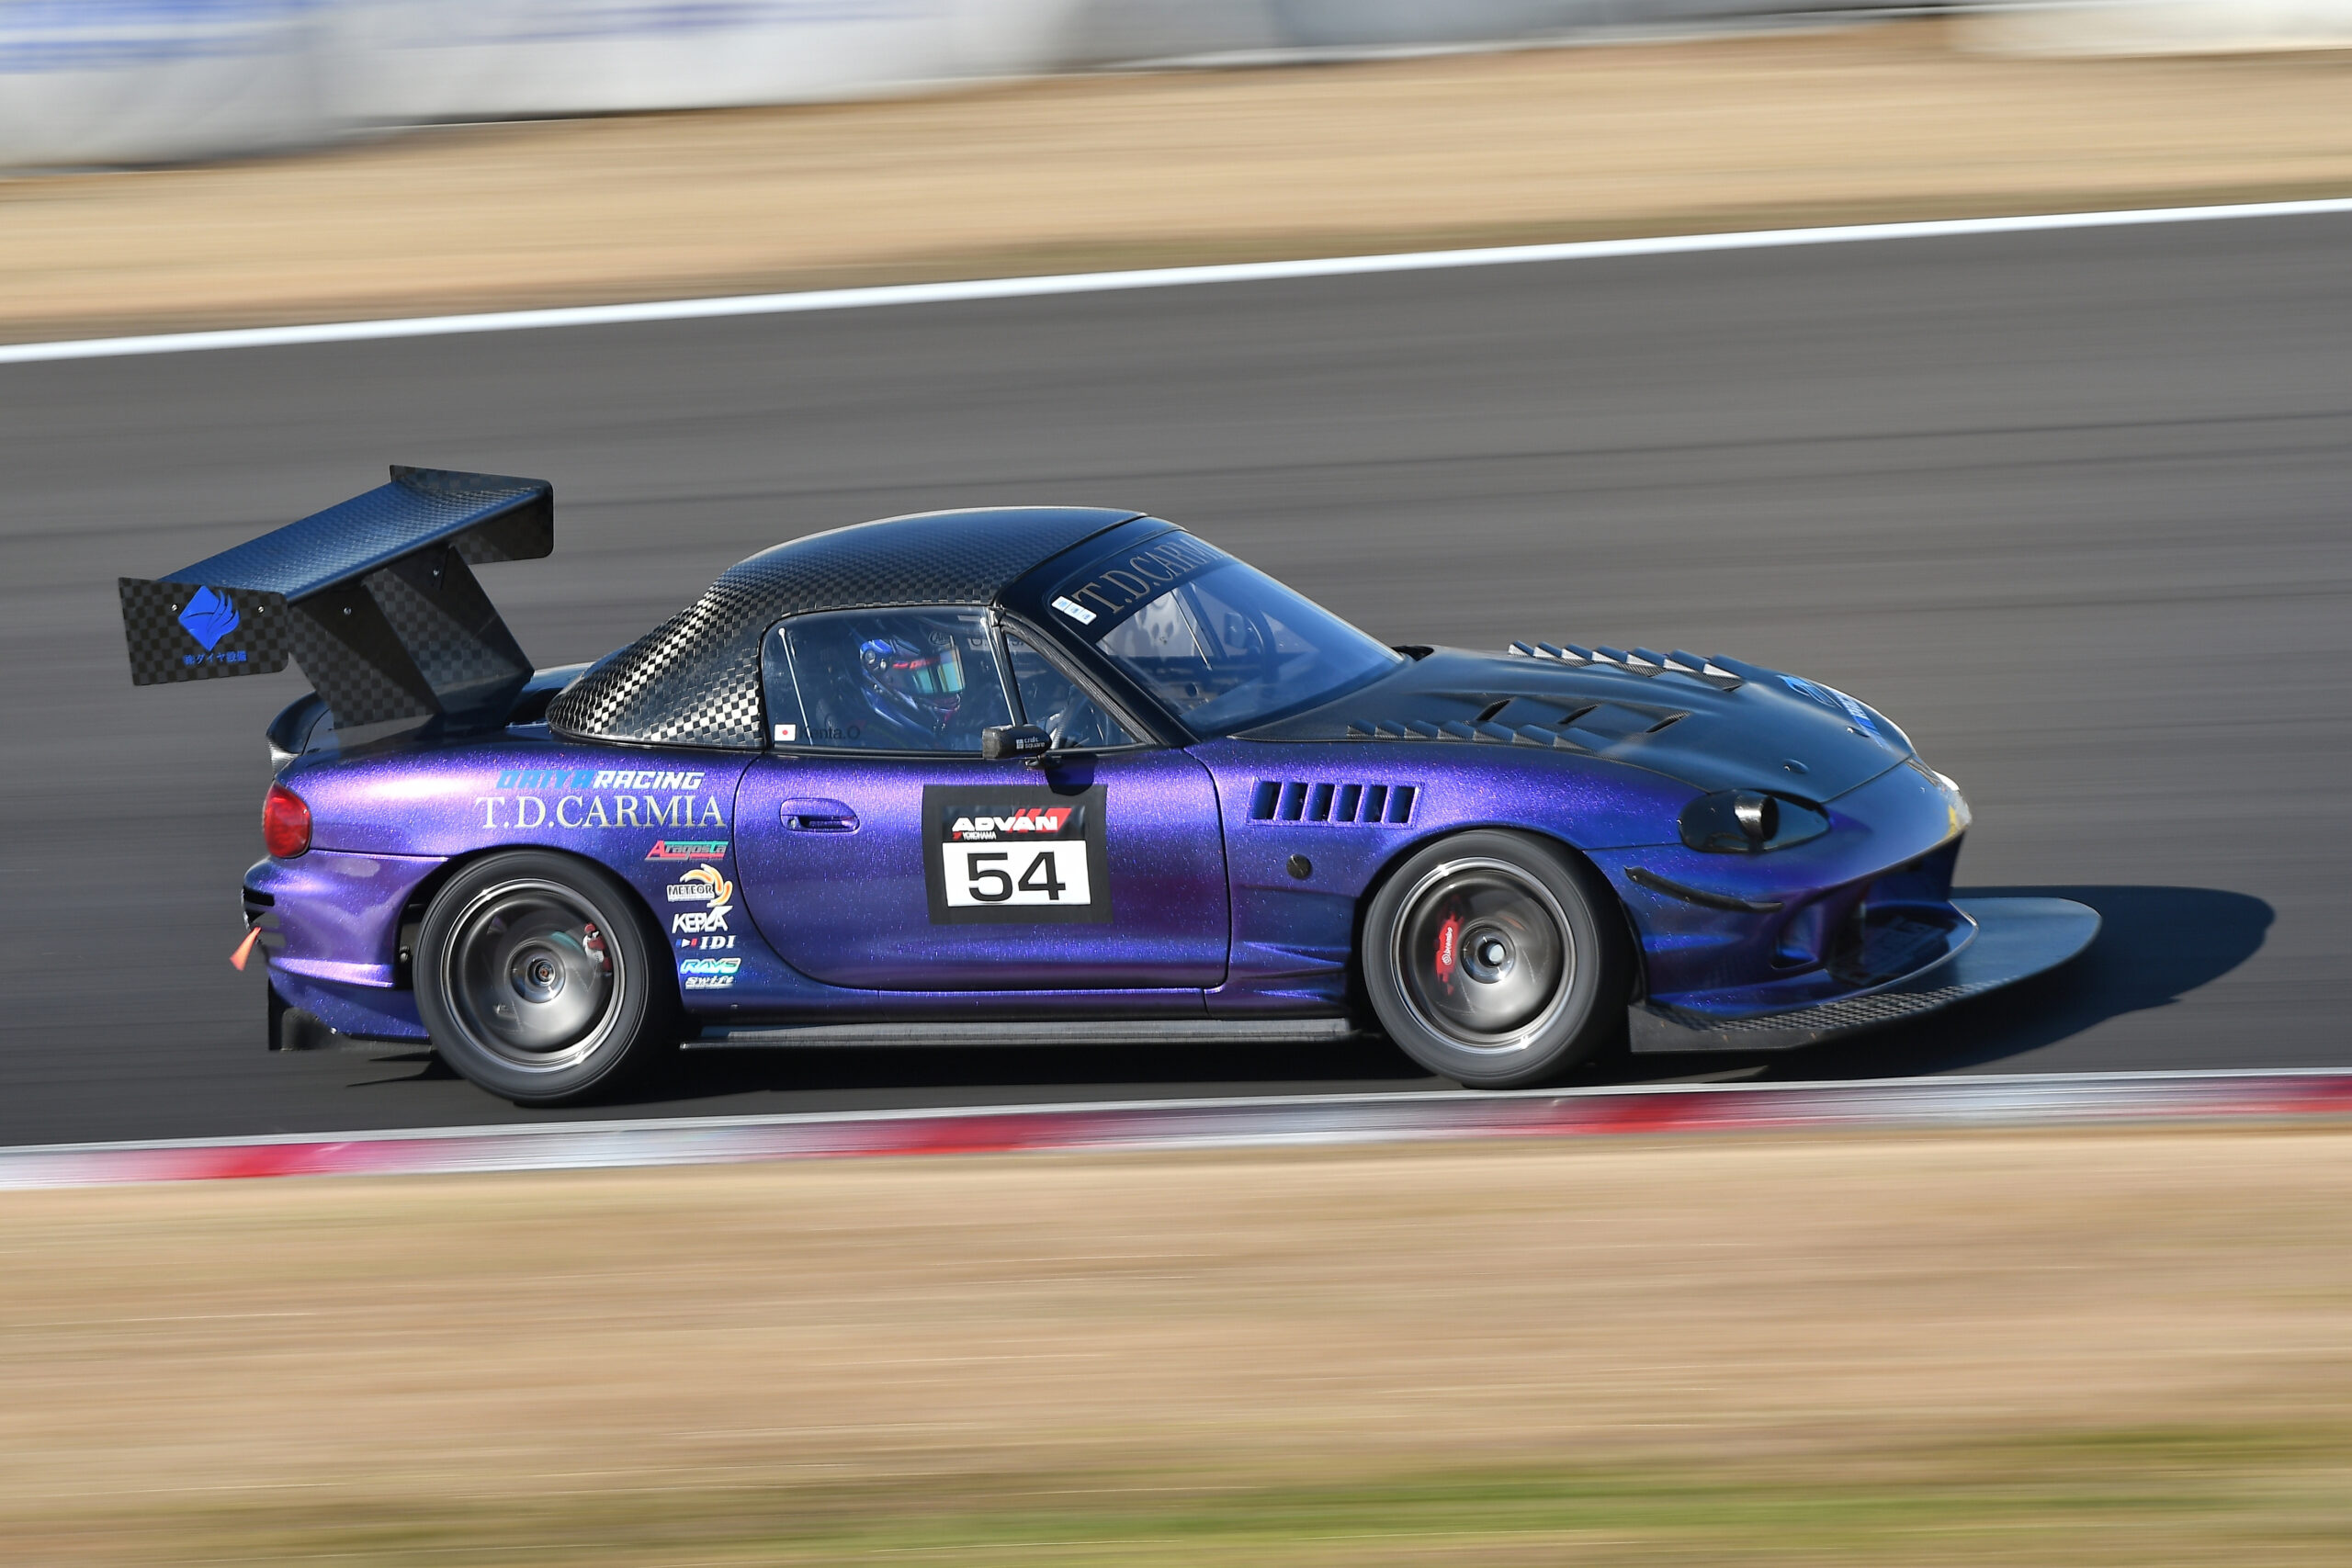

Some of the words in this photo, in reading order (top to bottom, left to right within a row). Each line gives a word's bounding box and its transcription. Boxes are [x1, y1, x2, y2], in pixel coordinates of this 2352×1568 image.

[474, 795, 728, 829] T.D.CARMIA
[952, 816, 1058, 832] ADVAN
[962, 830, 997, 840] YOKOHAMA
[645, 840, 729, 861] Aragosta
[967, 852, 1066, 902] 54
[668, 885, 713, 896] METEOR
[699, 935, 737, 950] IDI
[680, 957, 741, 975] RAYS
